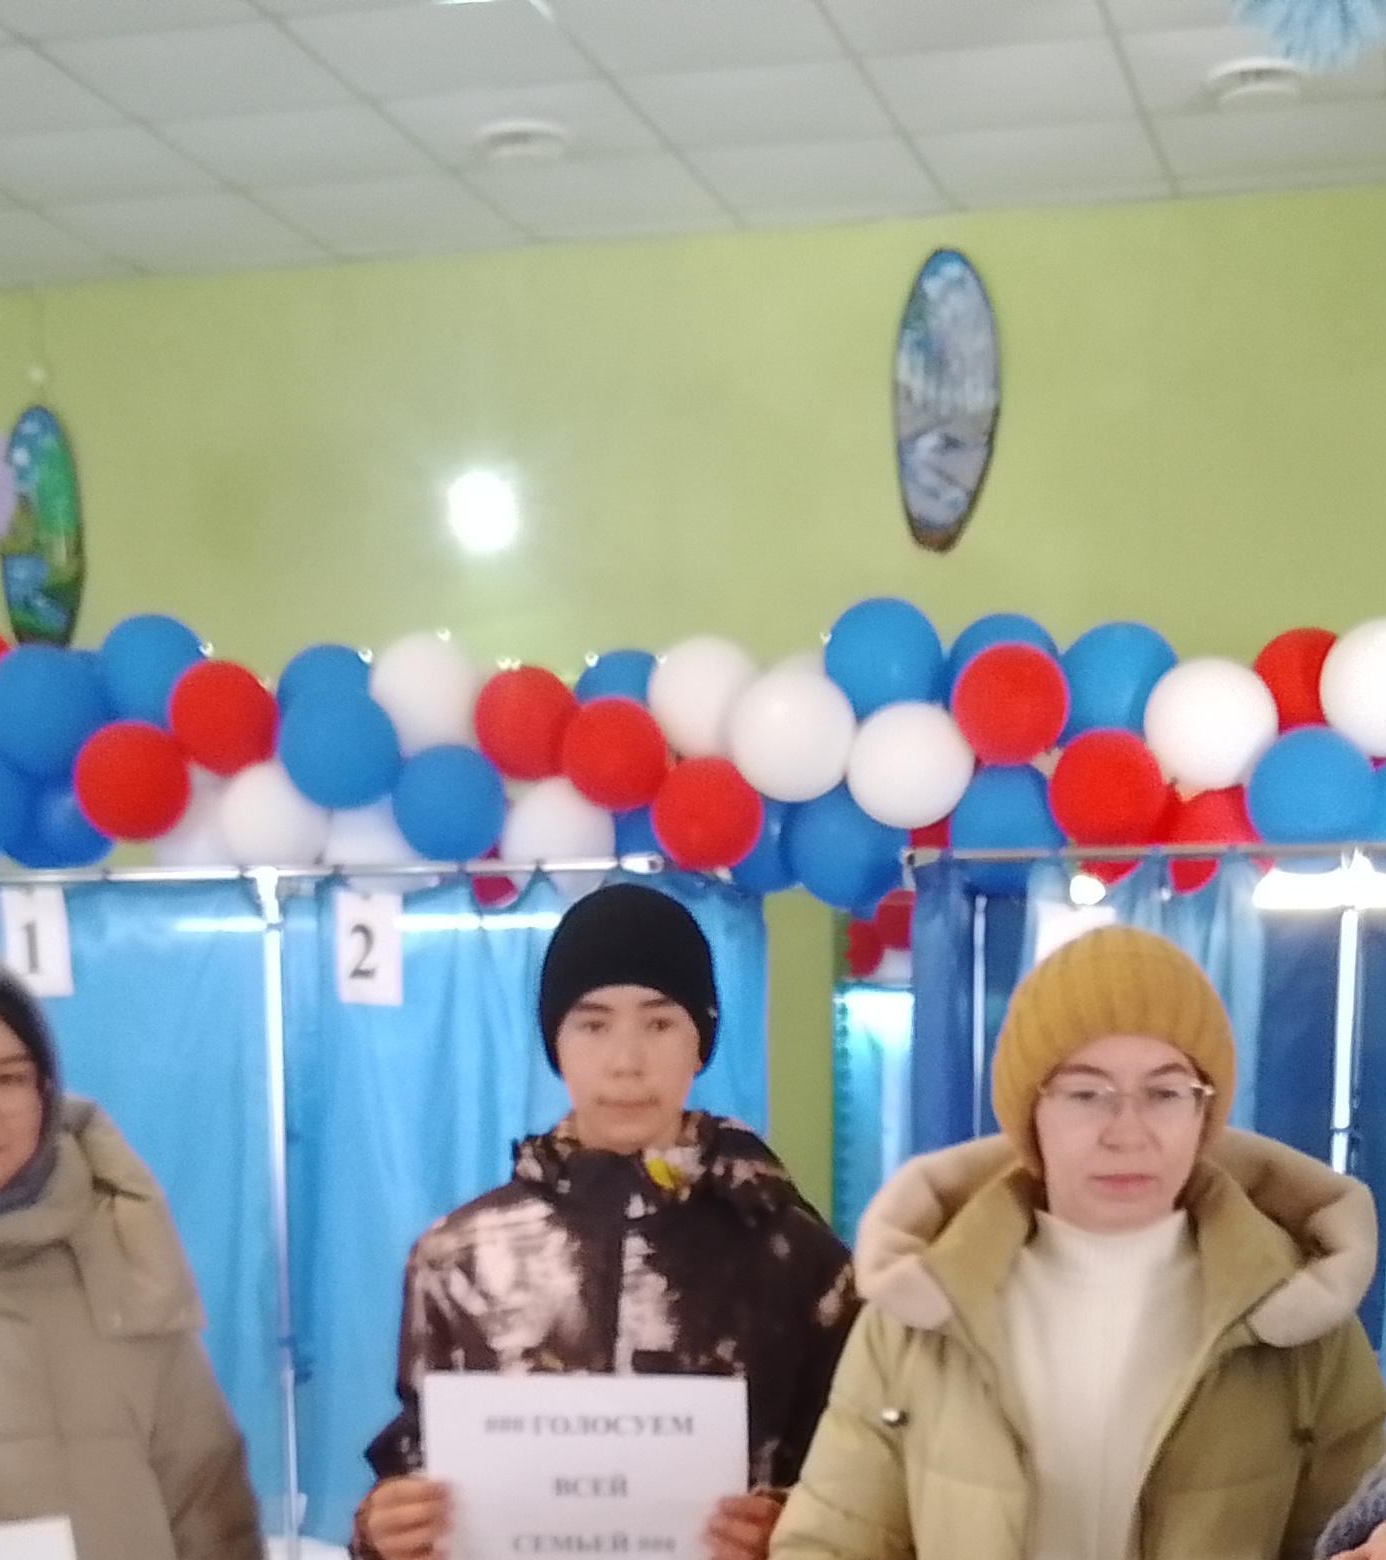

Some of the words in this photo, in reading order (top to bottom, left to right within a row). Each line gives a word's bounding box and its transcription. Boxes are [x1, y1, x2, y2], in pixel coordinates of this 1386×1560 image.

[21, 920, 42, 975] 1
[347, 923, 377, 980] 2
[554, 1473, 628, 1497] ВСЕЙ
